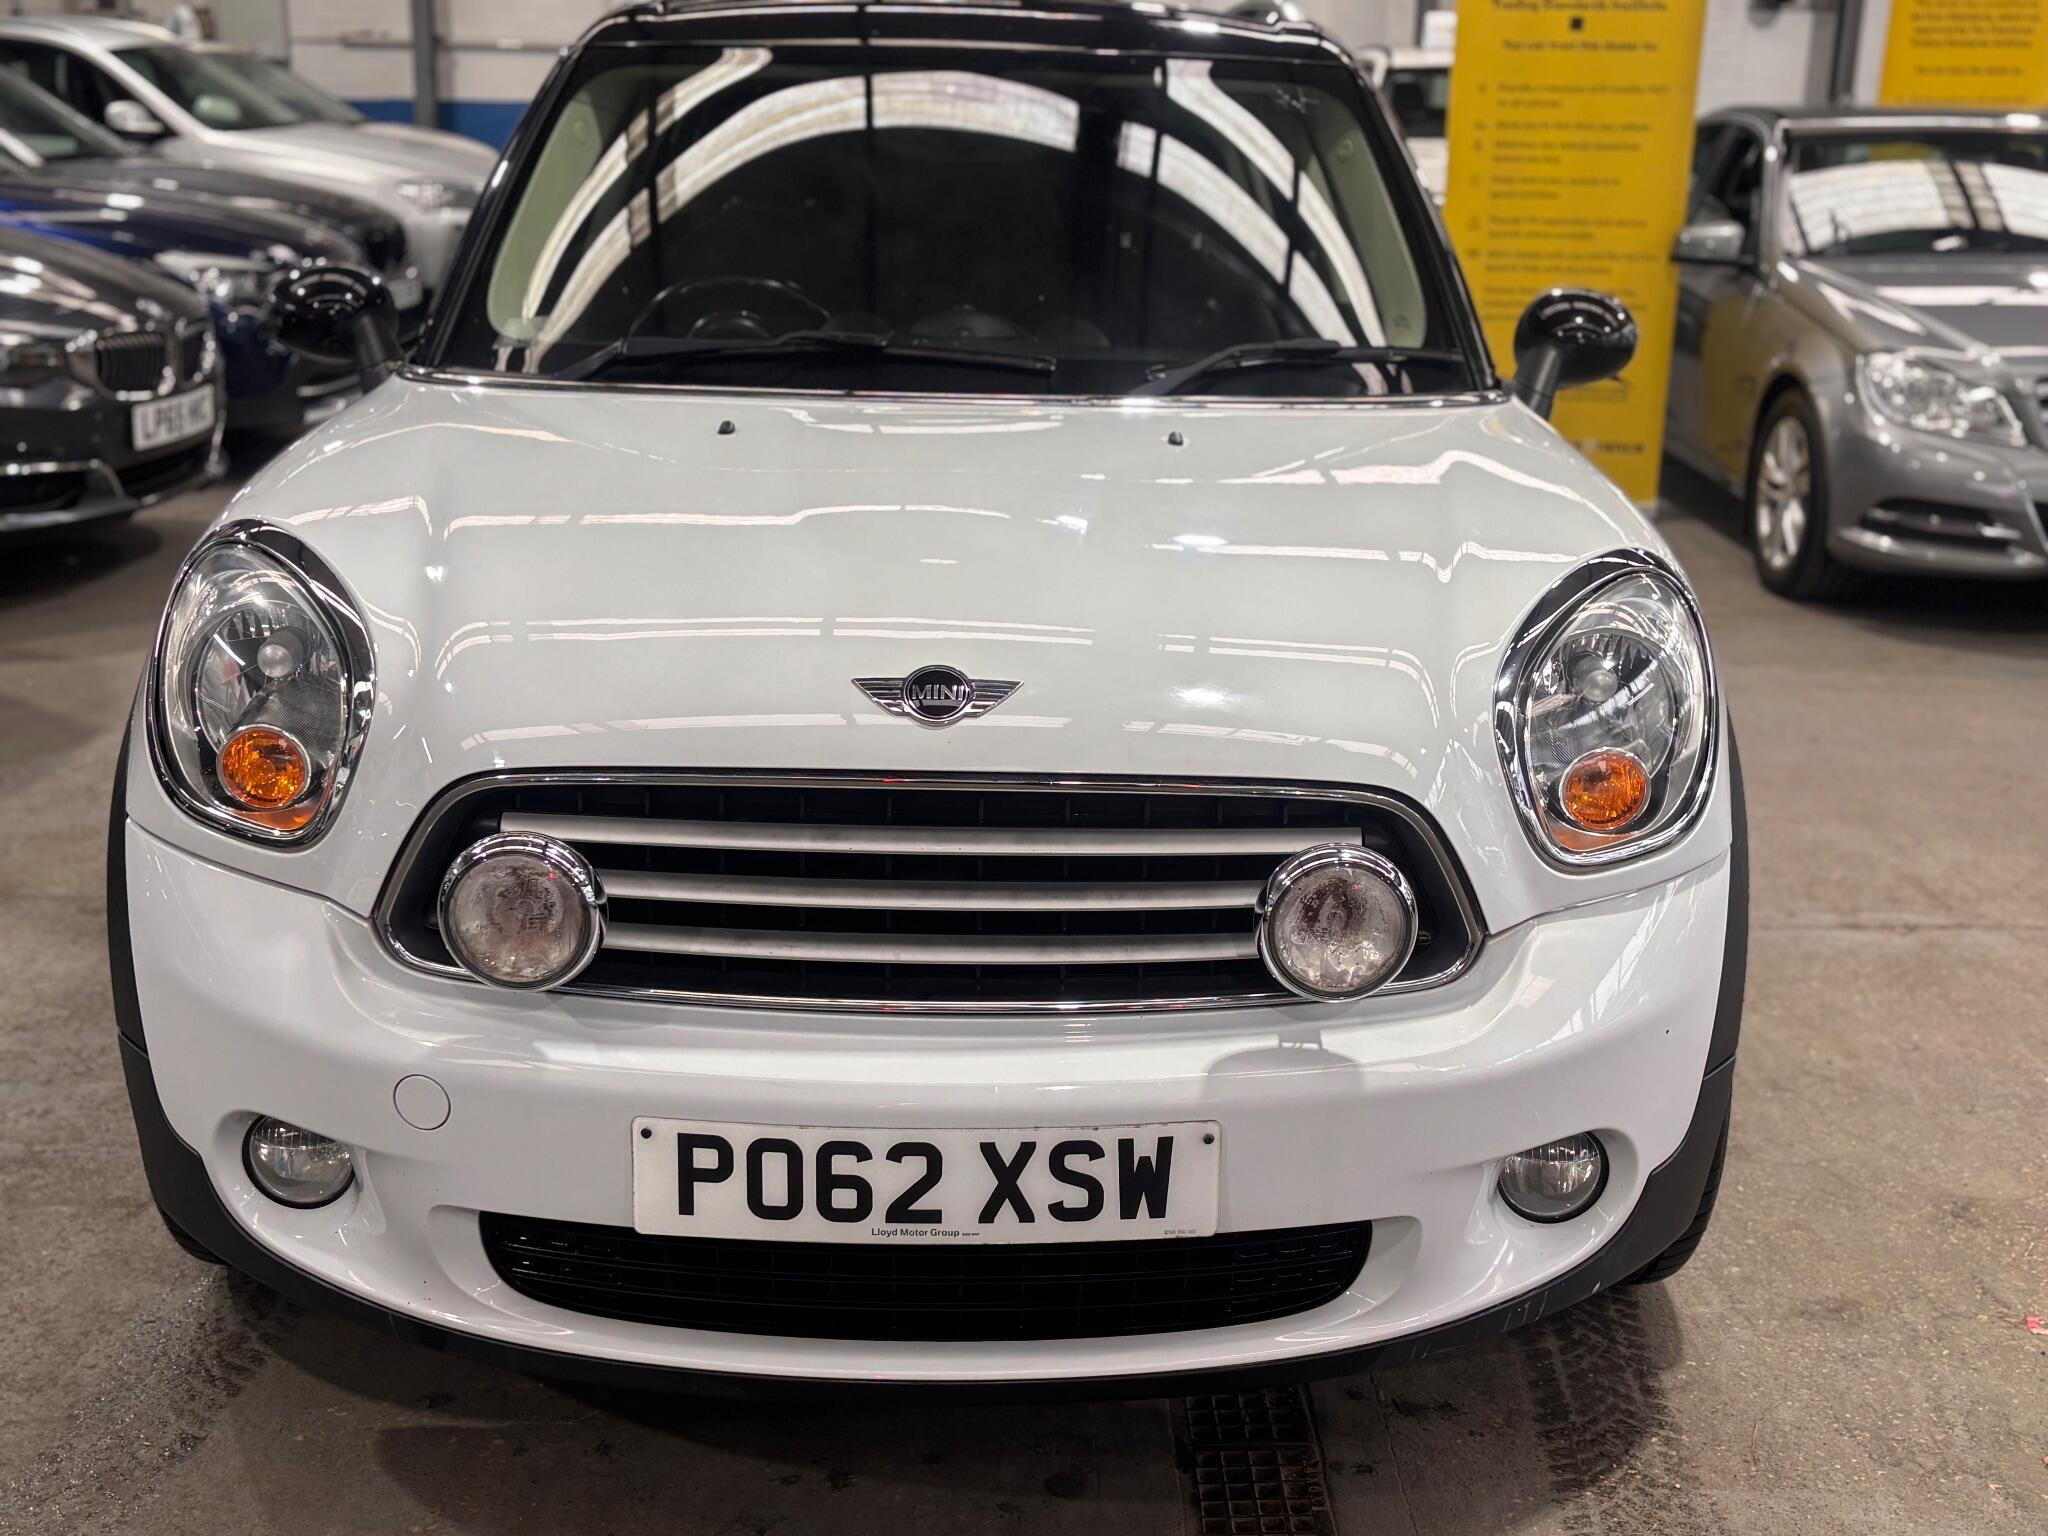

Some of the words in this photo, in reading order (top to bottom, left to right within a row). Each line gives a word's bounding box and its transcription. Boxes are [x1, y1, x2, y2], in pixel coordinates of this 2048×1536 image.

[911, 684, 965, 701] MINI
[677, 1132, 943, 1225] PO62
[978, 1135, 1174, 1224] XSW
[871, 1228, 898, 1238] Lloyd
[900, 1228, 928, 1237] Motor
[930, 1228, 960, 1239] Group
